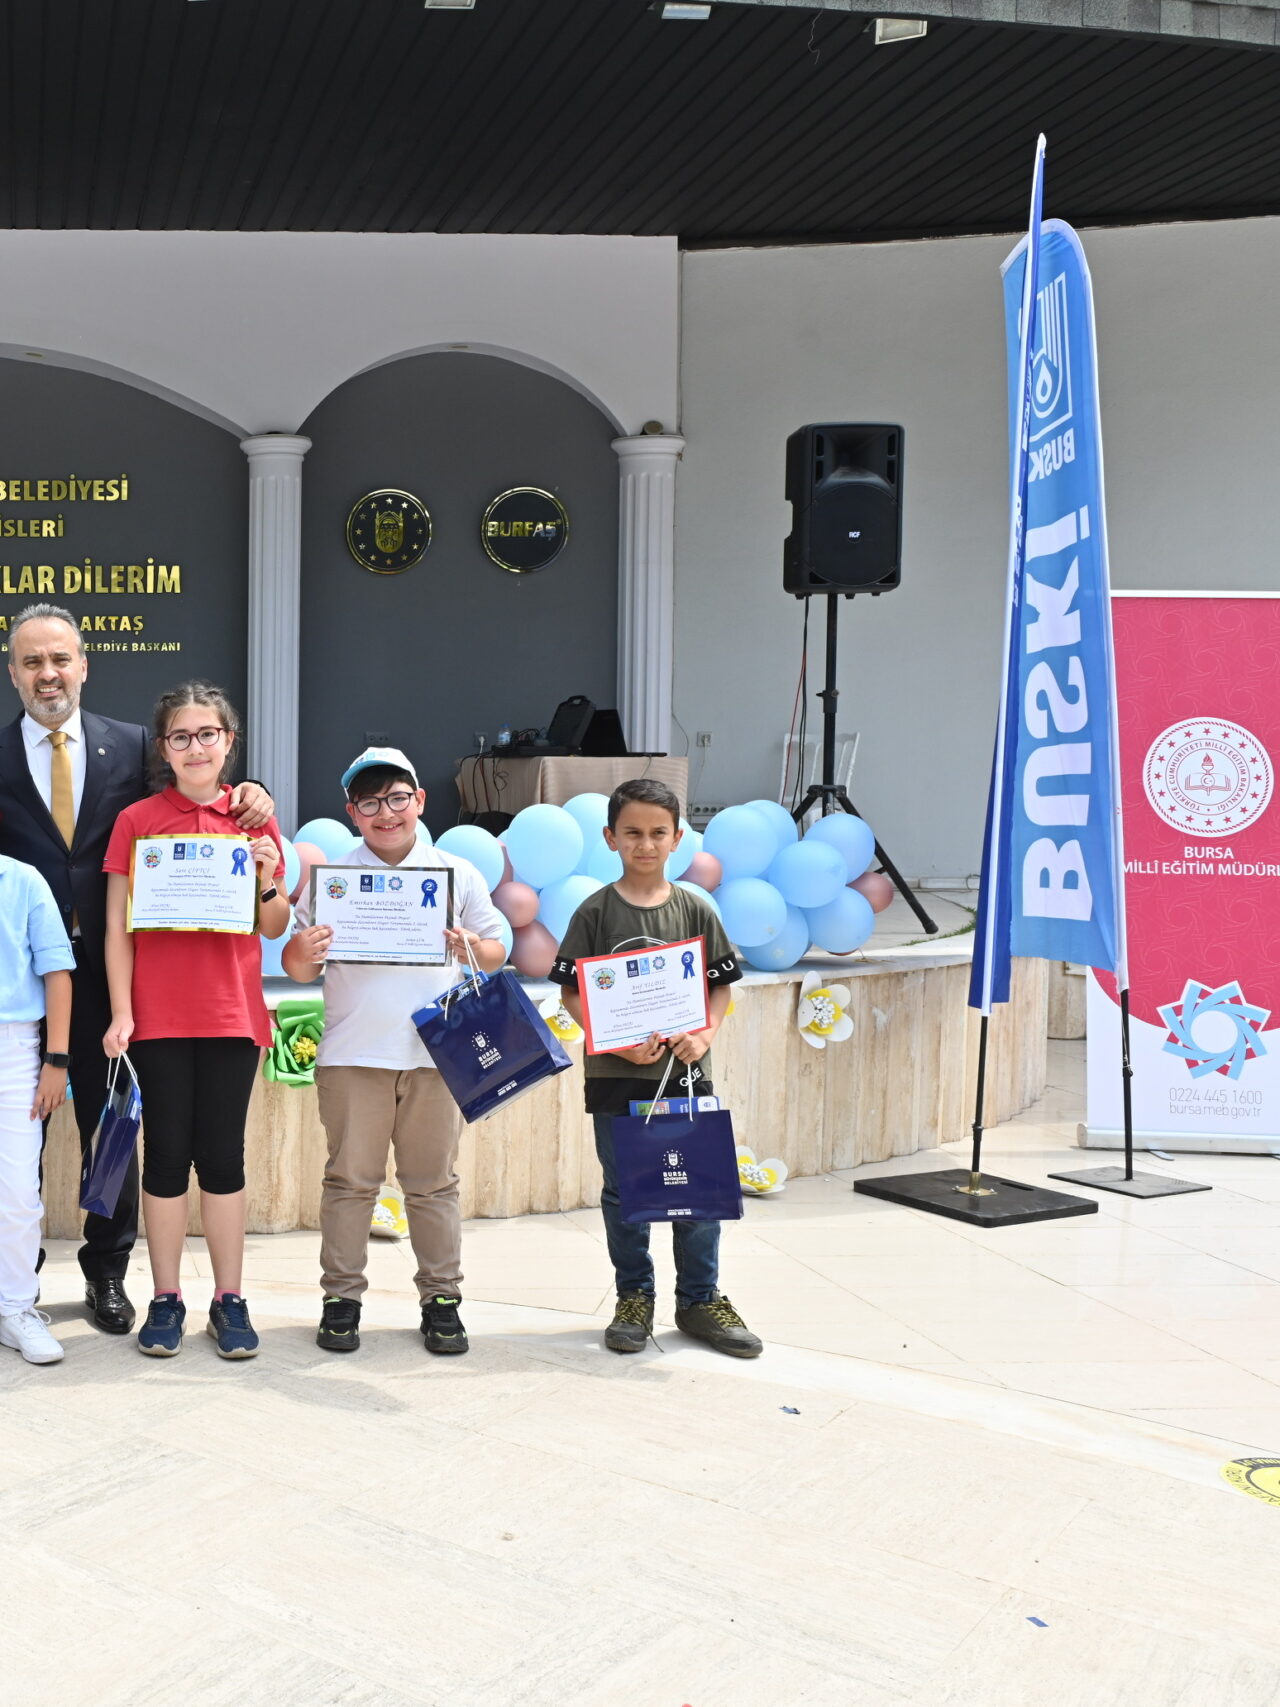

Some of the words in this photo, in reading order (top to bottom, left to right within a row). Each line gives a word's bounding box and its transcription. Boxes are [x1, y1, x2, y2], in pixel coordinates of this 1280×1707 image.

[848, 531, 861, 539] RCF
[63, 557, 181, 594] DİLERİM
[80, 615, 145, 635] AKTAŞ
[84, 640, 128, 652] ELEDİYE
[1184, 846, 1234, 860] BURSA
[1161, 860, 1215, 875] EĞİTİM
[1169, 1087, 1200, 1102] 0224
[1204, 1088, 1228, 1104] 445
[1232, 1089, 1263, 1105] 1600
